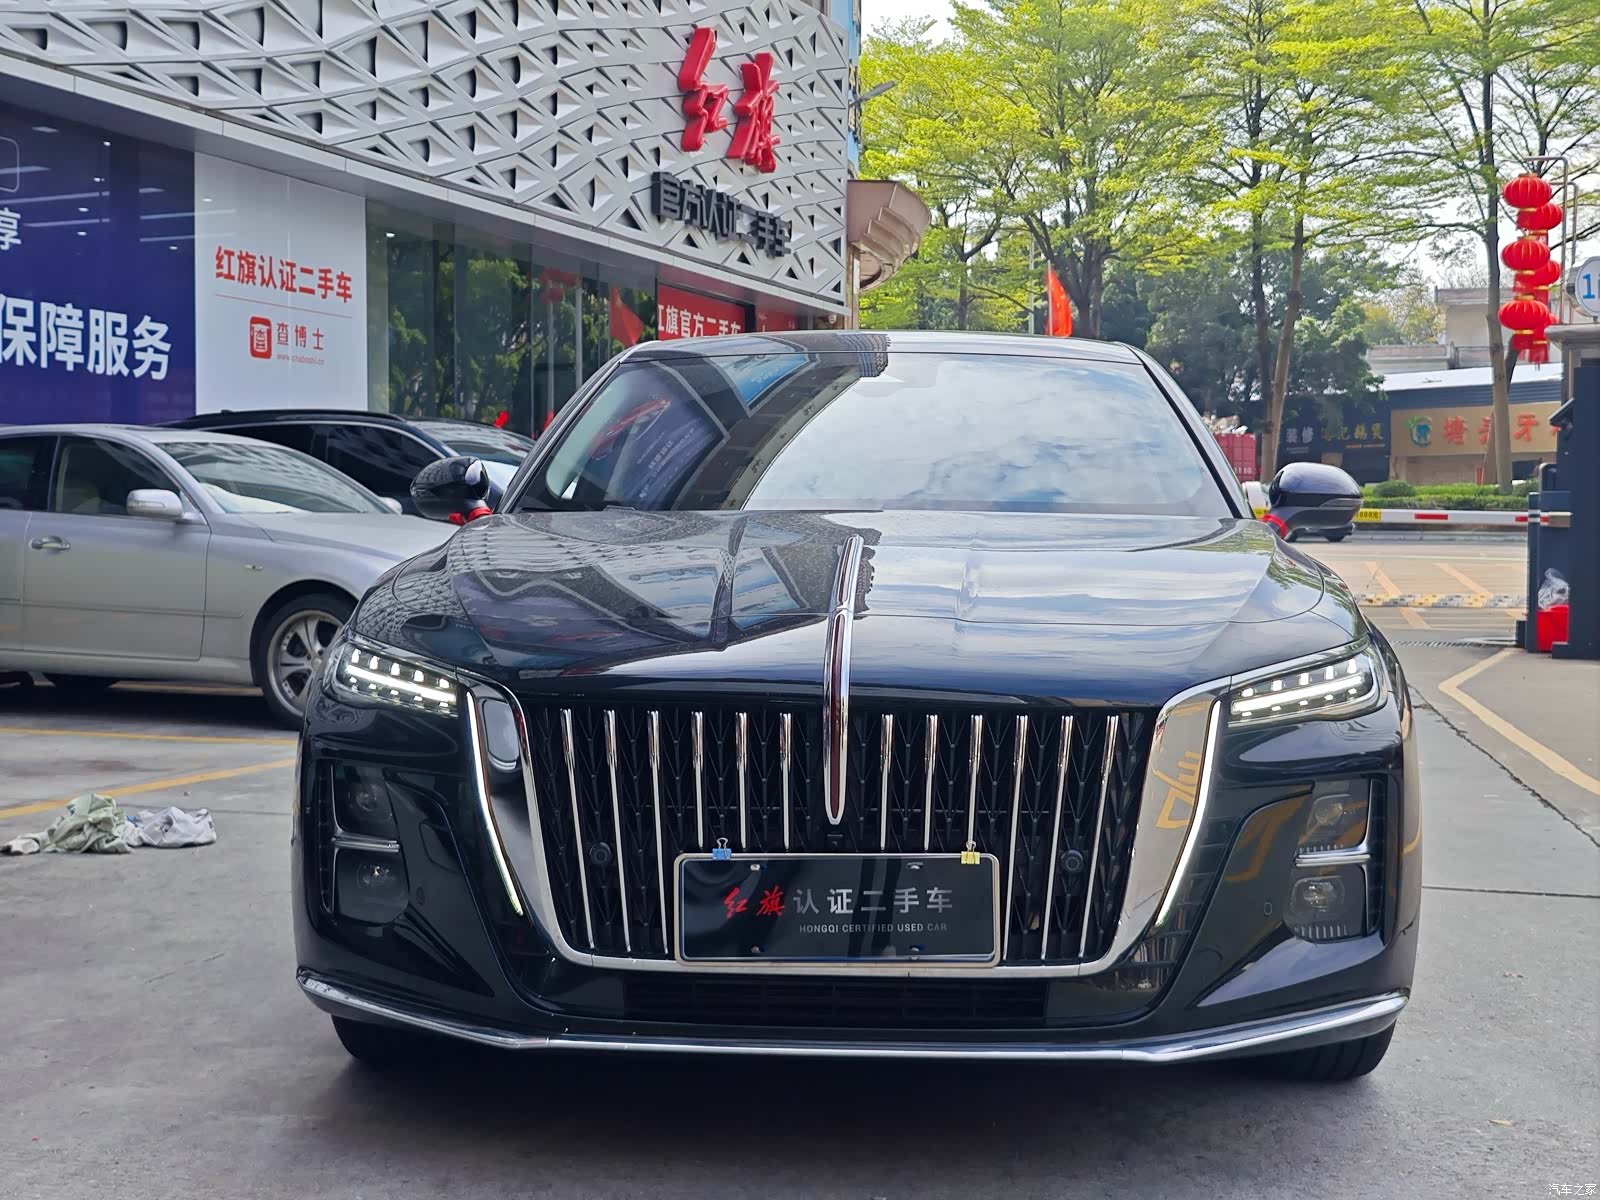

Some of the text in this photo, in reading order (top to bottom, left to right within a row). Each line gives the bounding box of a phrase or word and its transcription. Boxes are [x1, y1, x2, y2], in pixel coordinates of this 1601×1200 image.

[677, 26, 780, 173] 红旗
[651, 171, 792, 258] 官方认证二手车
[215, 245, 352, 303] 红旗认证二手车
[0, 293, 171, 380] 保障服务
[1443, 413, 1562, 445] 塘头牙
[724, 885, 953, 919] 红旗认证二手车
[800, 923, 948, 934] HONGQI CERTIFIED USED CAR
